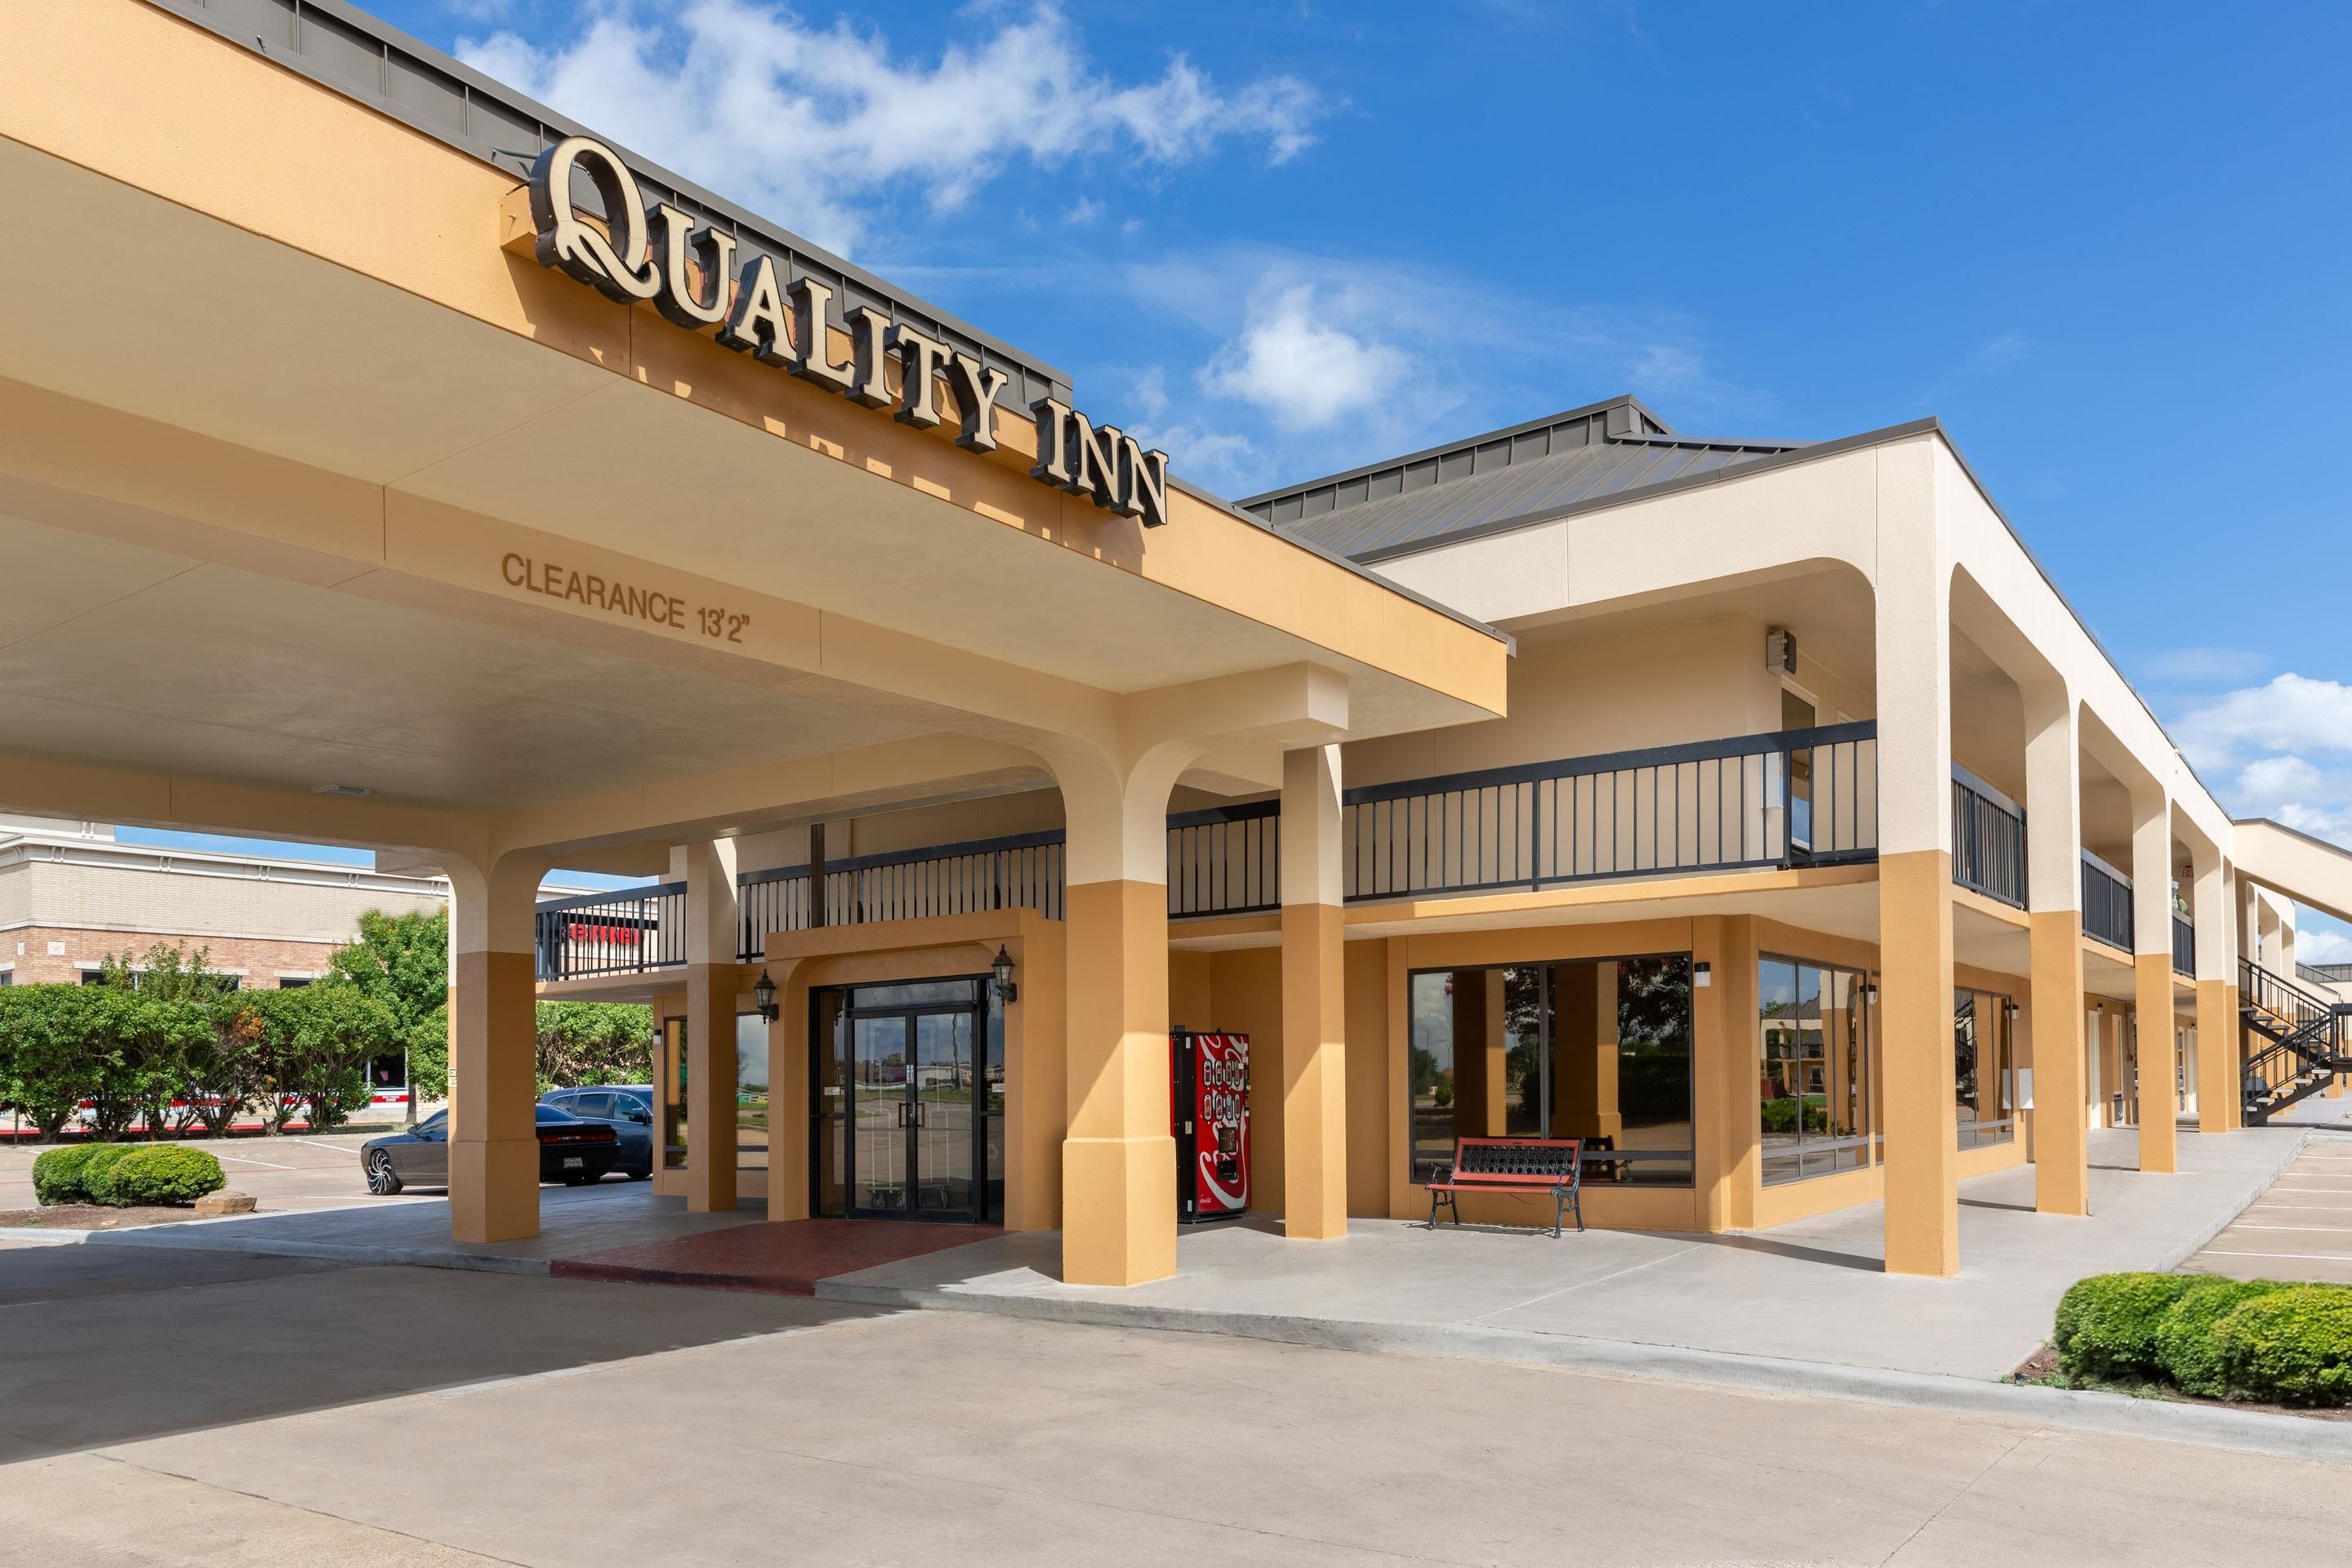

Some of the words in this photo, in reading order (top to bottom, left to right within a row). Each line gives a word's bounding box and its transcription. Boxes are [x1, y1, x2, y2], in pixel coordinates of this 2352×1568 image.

[531, 136, 1008, 454] QUALITY
[1030, 397, 1169, 529] INN
[501, 552, 685, 630] CLEARANCE
